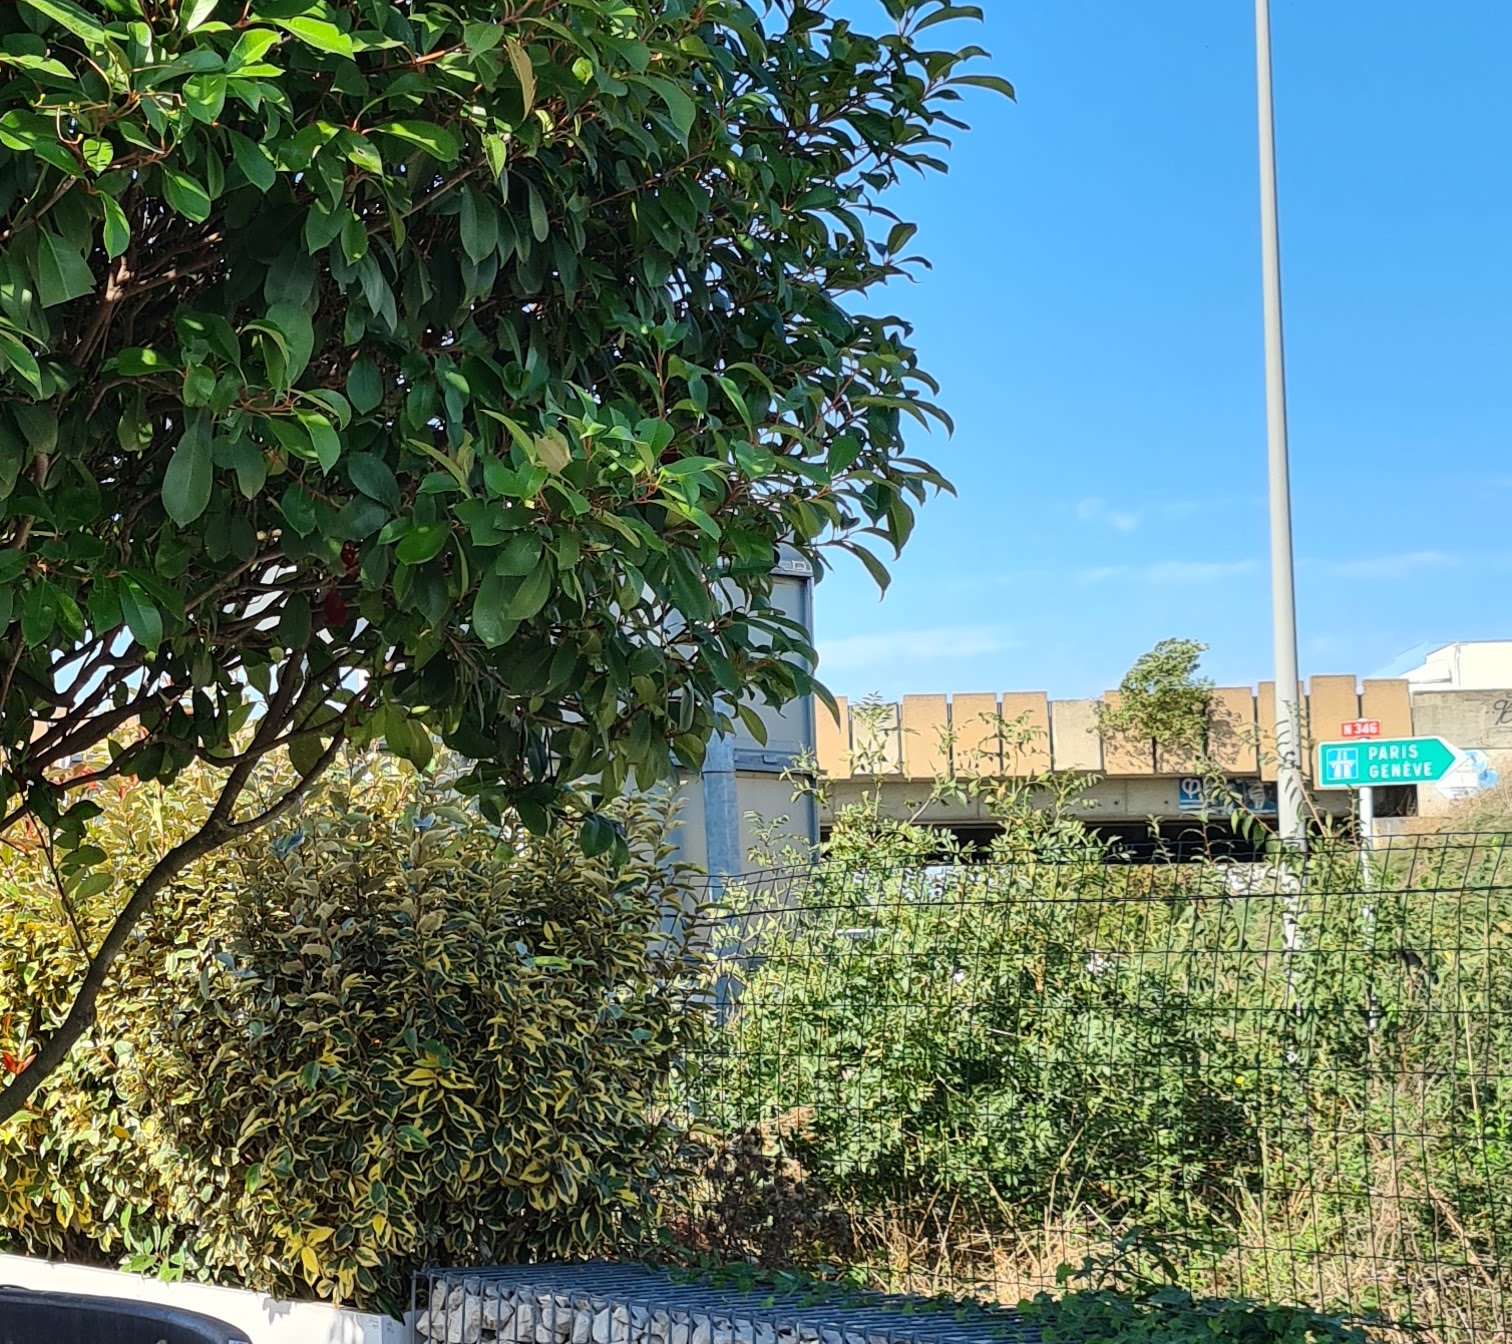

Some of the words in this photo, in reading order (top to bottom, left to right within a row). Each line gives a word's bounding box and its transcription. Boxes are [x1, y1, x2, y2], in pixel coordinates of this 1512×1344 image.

[1343, 724, 1353, 735] N
[1354, 722, 1378, 735] 346
[1368, 744, 1419, 761] PARIS
[1369, 760, 1433, 779] GENÈVE
